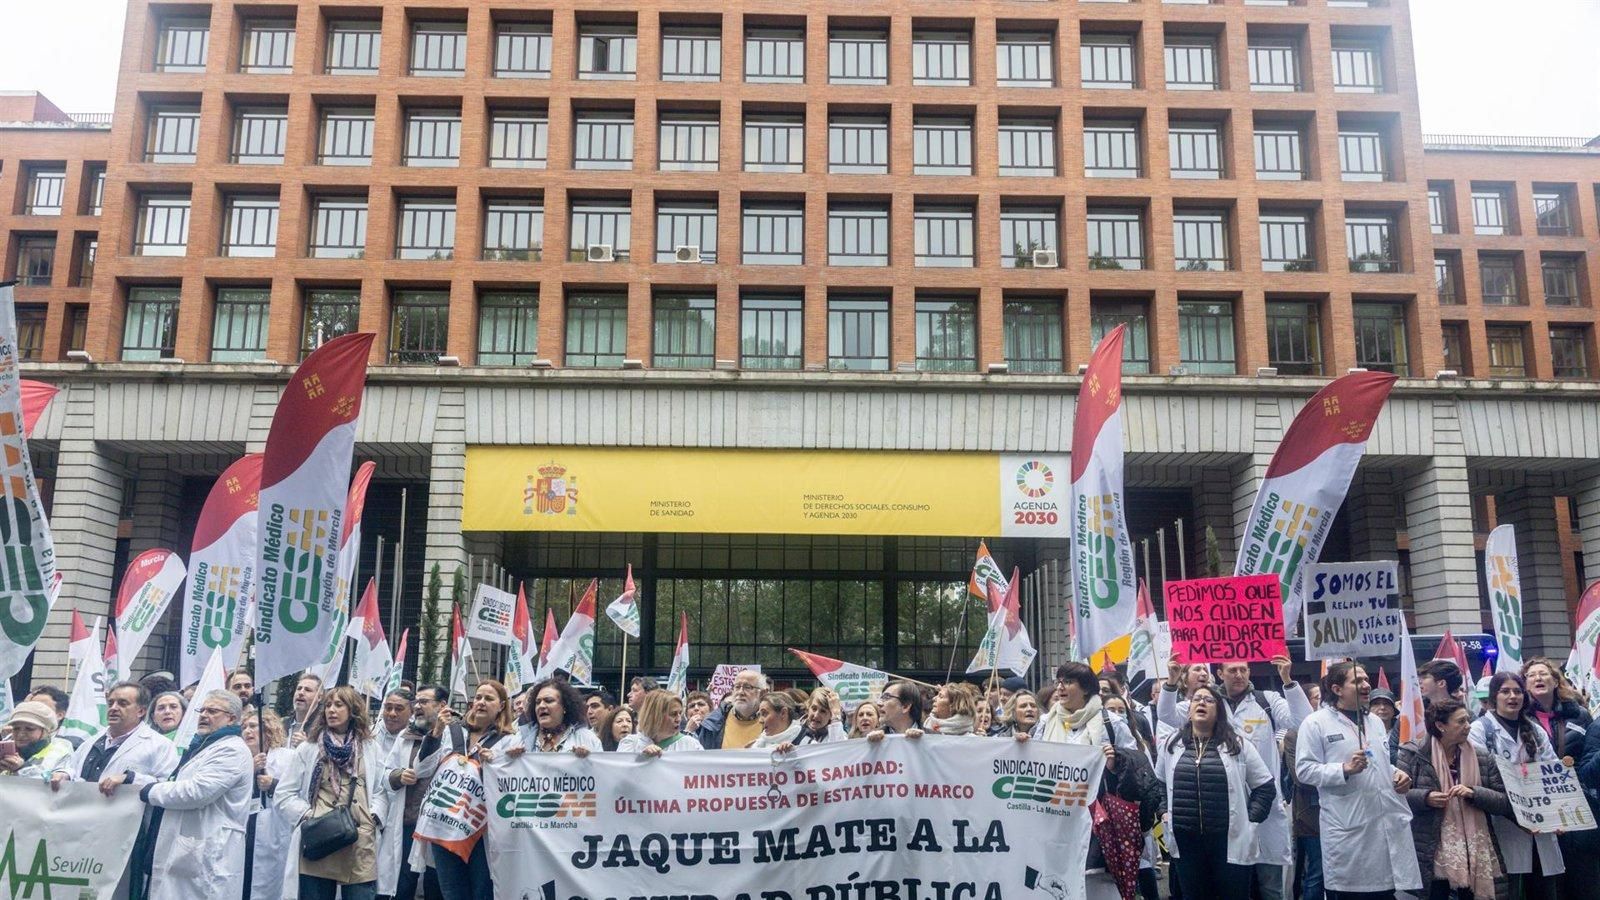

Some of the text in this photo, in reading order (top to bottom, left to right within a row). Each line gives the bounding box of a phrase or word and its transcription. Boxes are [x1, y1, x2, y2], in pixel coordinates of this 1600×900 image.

[650, 500, 691, 508] MINISTERIO
[661, 509, 695, 517] SANIDAD
[814, 503, 854, 511] DERECHOS
[856, 504, 891, 512] SOCIALES,
[1014, 501, 1058, 511] AGENDA
[1014, 511, 1058, 525] 2030
[1251, 491, 1281, 543] Médico
[328, 508, 342, 555] Murcia
[1308, 510, 1332, 561] de Murcia
[140, 553, 165, 568] Murcia
[1077, 493, 1091, 619] Sindicato Médico
[1086, 493, 1119, 610] CESM
[256, 503, 285, 644] Sindicato Médico
[278, 508, 329, 634] CESM
[329, 555, 337, 573] de
[1121, 548, 1133, 588] Región
[321, 575, 334, 613] Región
[1244, 583, 1280, 600] QUE
[1312, 571, 1372, 600] SOMOS
[1376, 570, 1395, 590] EL
[186, 561, 209, 656] Sindicato Médico
[202, 565, 241, 649] CESM
[234, 566, 253, 636] Región de Murcia
[1368, 597, 1387, 610] TU
[1173, 604, 1204, 622] NOS
[1386, 615, 1399, 626] EN
[1171, 627, 1199, 642] PARA
[1312, 616, 1358, 649] SALUD
[1361, 632, 1395, 645] JUEGO
[1188, 640, 1267, 661] MEJOR
[827, 671, 886, 681] Sindicato Médico
[683, 760, 904, 789] MINISTERIO DE SANIDAD:
[993, 759, 1089, 783] SINDICATO MÉDICO
[1540, 763, 1564, 776] NO
[497, 773, 596, 793] SINDICATO MÉDICO
[991, 775, 1090, 807] CESM
[1543, 784, 1578, 795] ECHES
[496, 793, 597, 819] CESM
[615, 783, 975, 814] ÚLTIMA PROPUESTA DE ESTATUTO MARCO
[1006, 802, 1031, 811] Castilla
[1036, 805, 1045, 813] La
[1045, 807, 1071, 817] Mancha
[439, 813, 471, 837] Mancha
[539, 821, 549, 829] La
[550, 820, 578, 829] Mancha
[571, 818, 1011, 874] JAQUE MATE A LA
[50, 855, 104, 875] Sevilla
